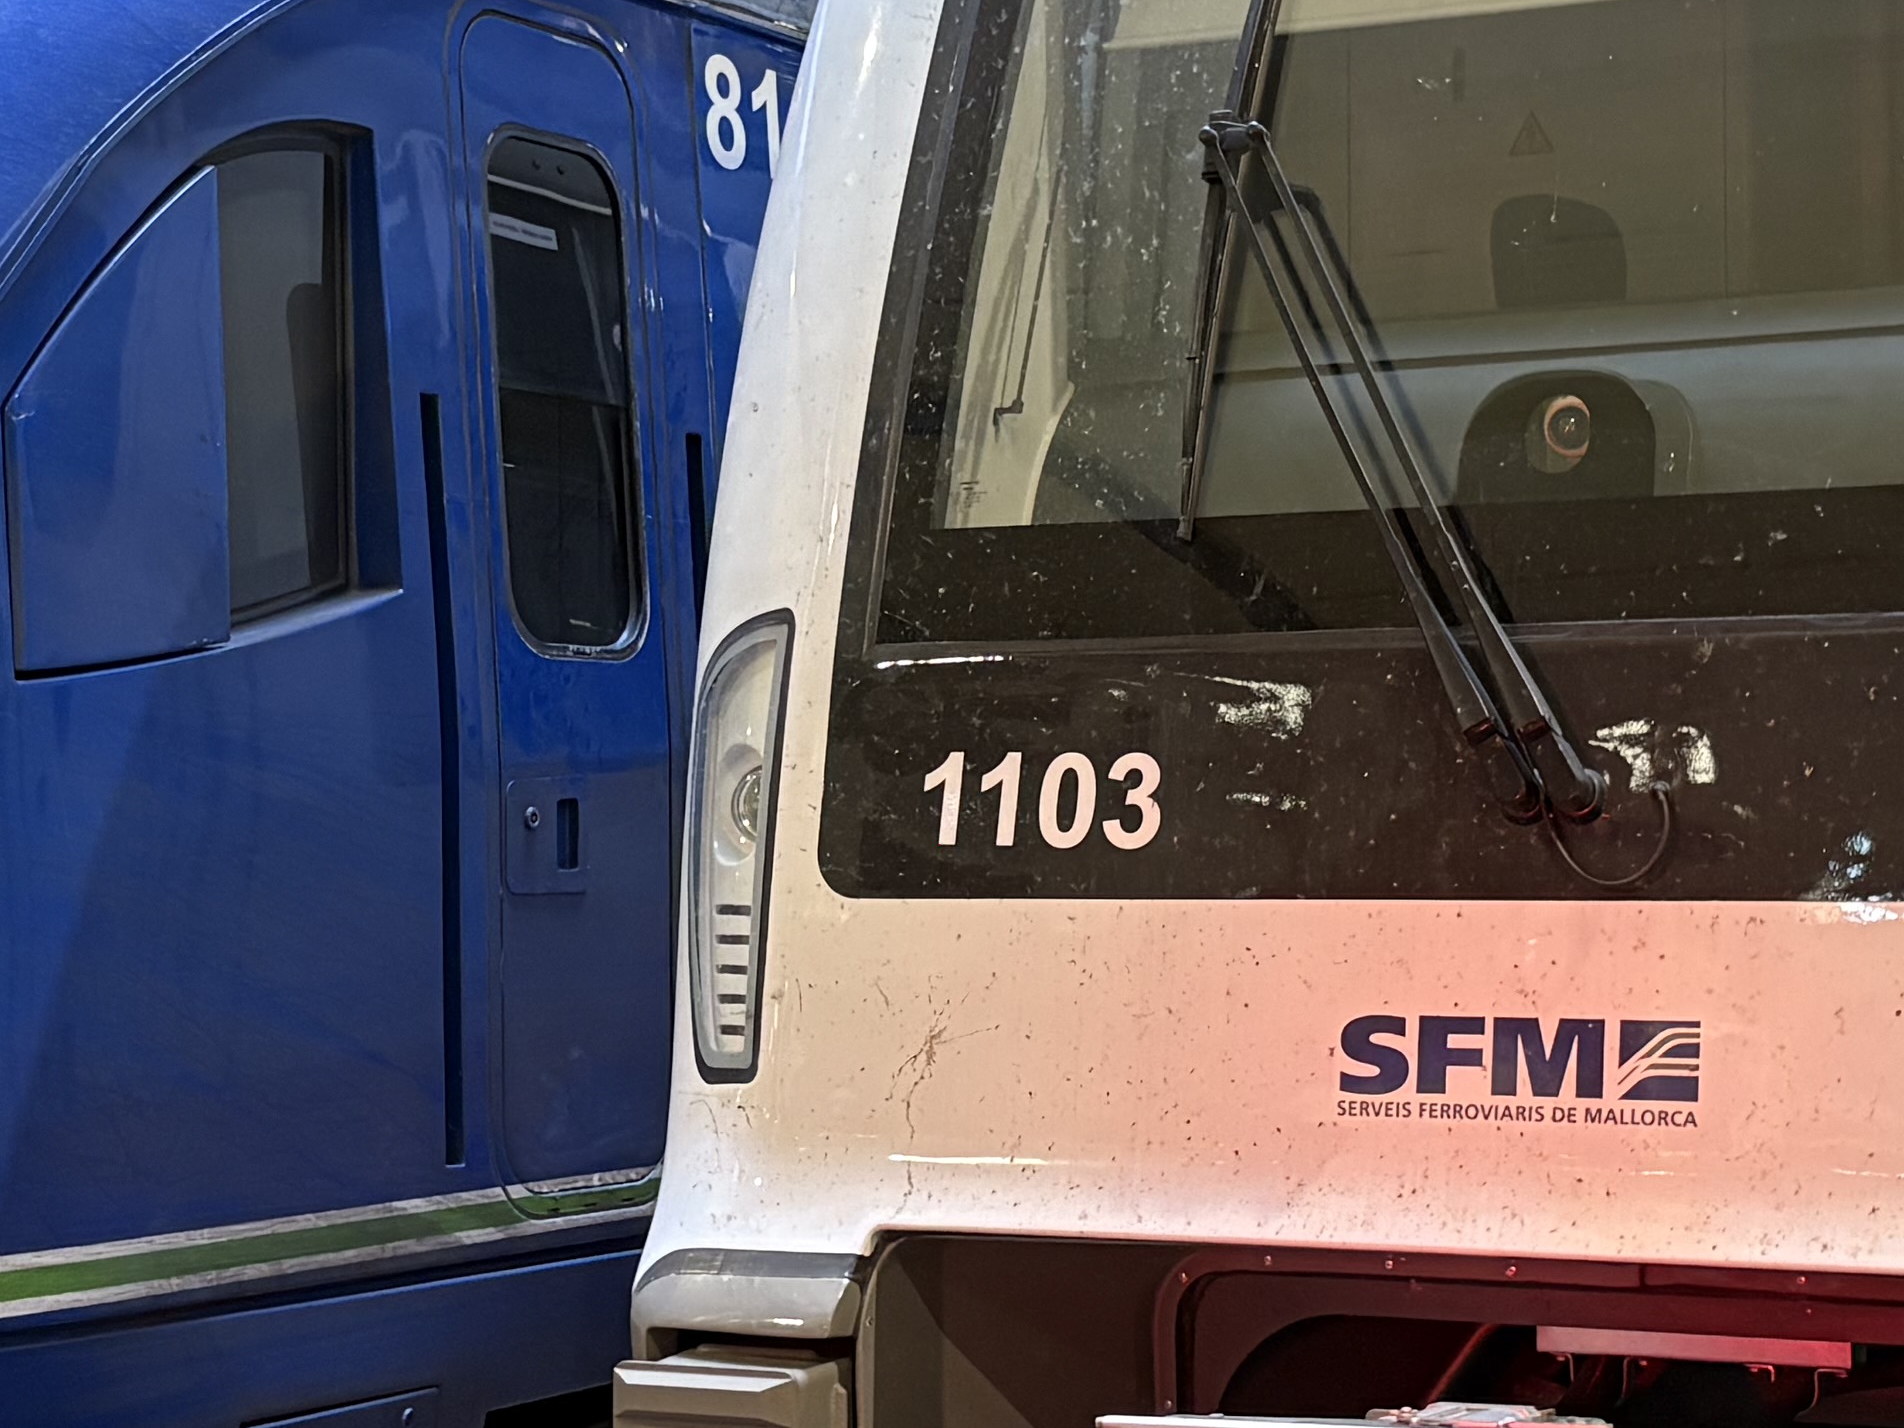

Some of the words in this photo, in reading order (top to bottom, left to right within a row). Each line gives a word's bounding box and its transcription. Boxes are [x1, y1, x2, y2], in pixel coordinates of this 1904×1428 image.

[923, 751, 1162, 851] 1103
[1339, 1014, 1606, 1100] SFM
[1337, 1099, 1412, 1119] SERVEIS
[1418, 1102, 1545, 1124] FERROVIARIS
[1551, 1106, 1578, 1124] DE
[1583, 1108, 1698, 1128] MALLORCA
